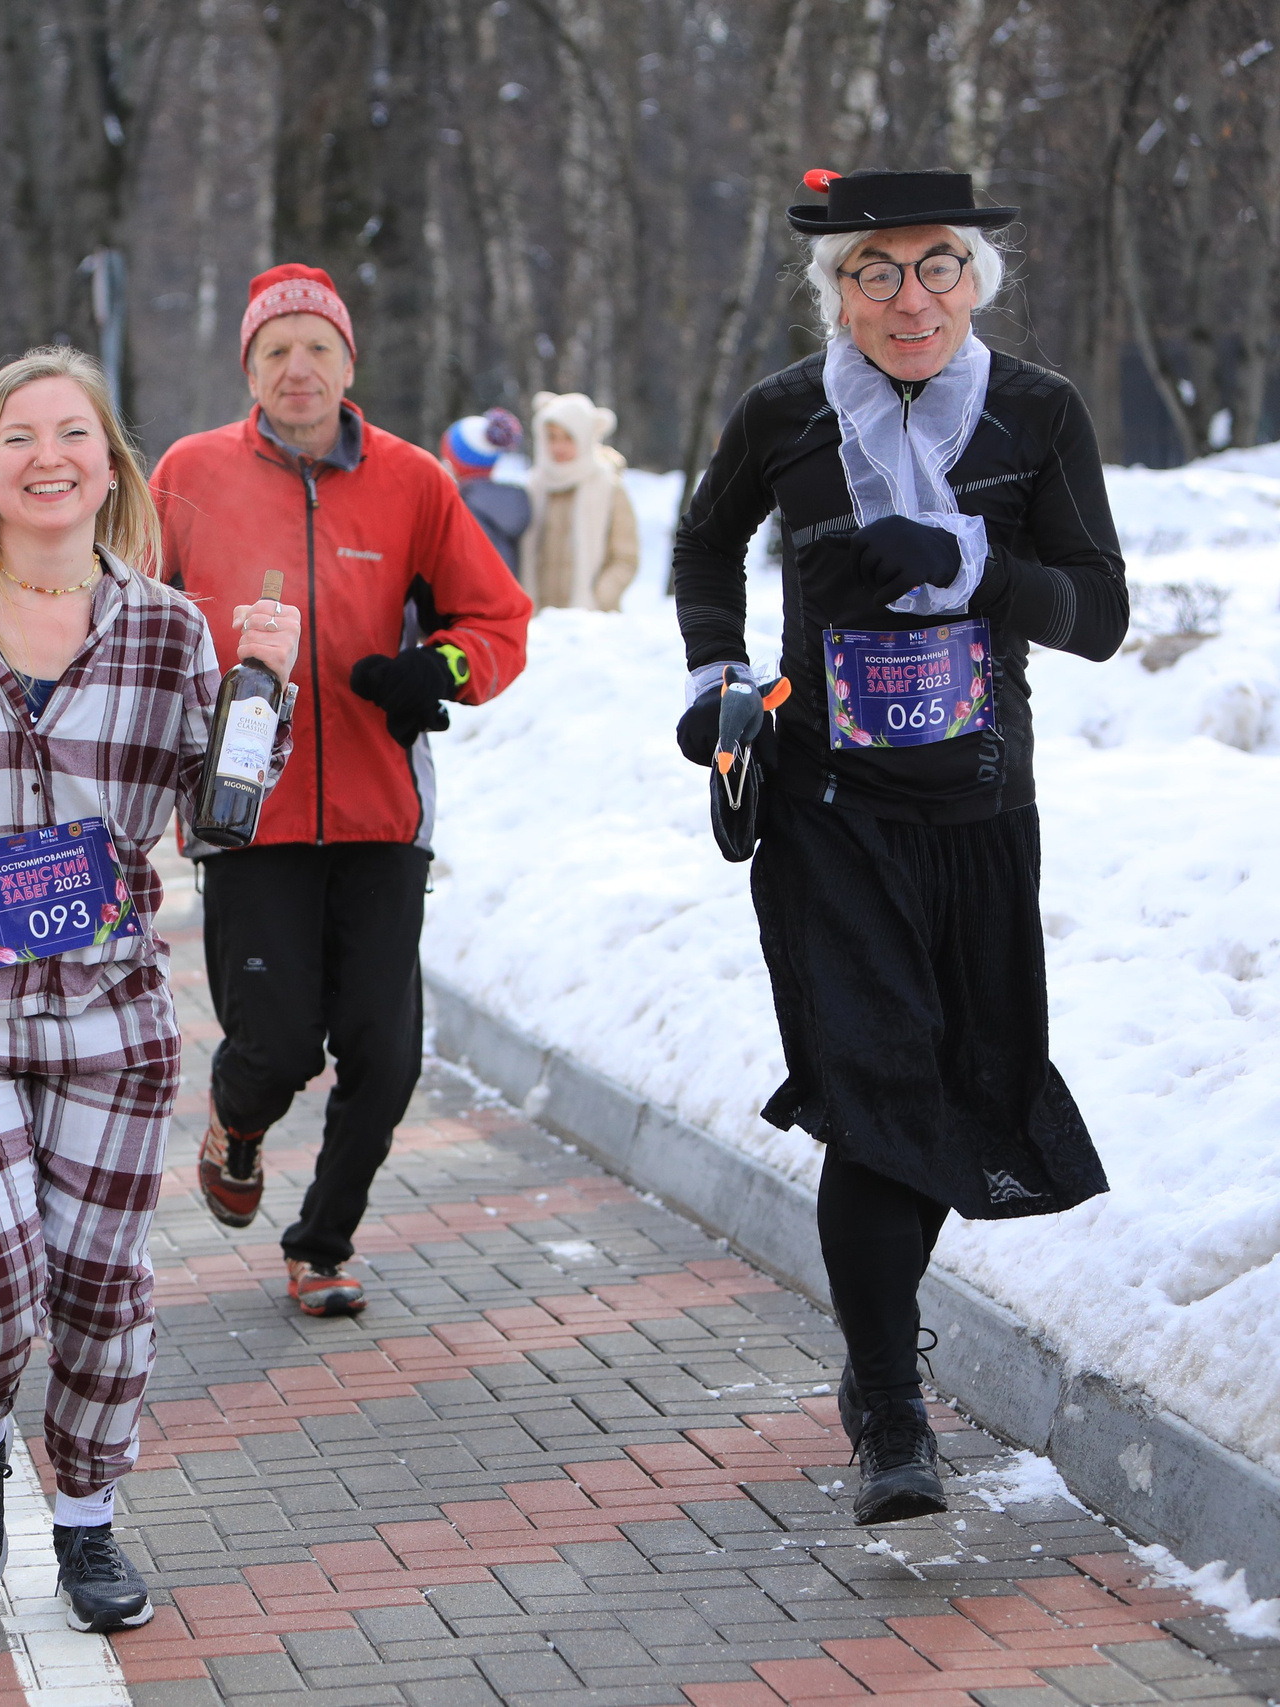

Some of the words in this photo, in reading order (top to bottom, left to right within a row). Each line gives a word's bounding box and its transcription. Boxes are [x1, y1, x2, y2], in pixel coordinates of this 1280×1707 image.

[909, 630, 927, 641] МЫ
[864, 648, 949, 664] КОСТЮМИРОВАННЫЙ
[866, 656, 951, 680] ЖЕНСКИЙ
[867, 679, 912, 693] ЗАБЕГ
[916, 673, 951, 691] 2023
[887, 697, 945, 730] 065
[237, 722, 268, 736] CLASSICO
[239, 716, 268, 730] CHIANTI
[223, 780, 256, 795] RIGODINA
[39, 827, 58, 840] МЫ
[1, 882, 49, 905] ЗАБЕГ
[54, 872, 91, 893] 2023
[28, 899, 91, 939] 093
